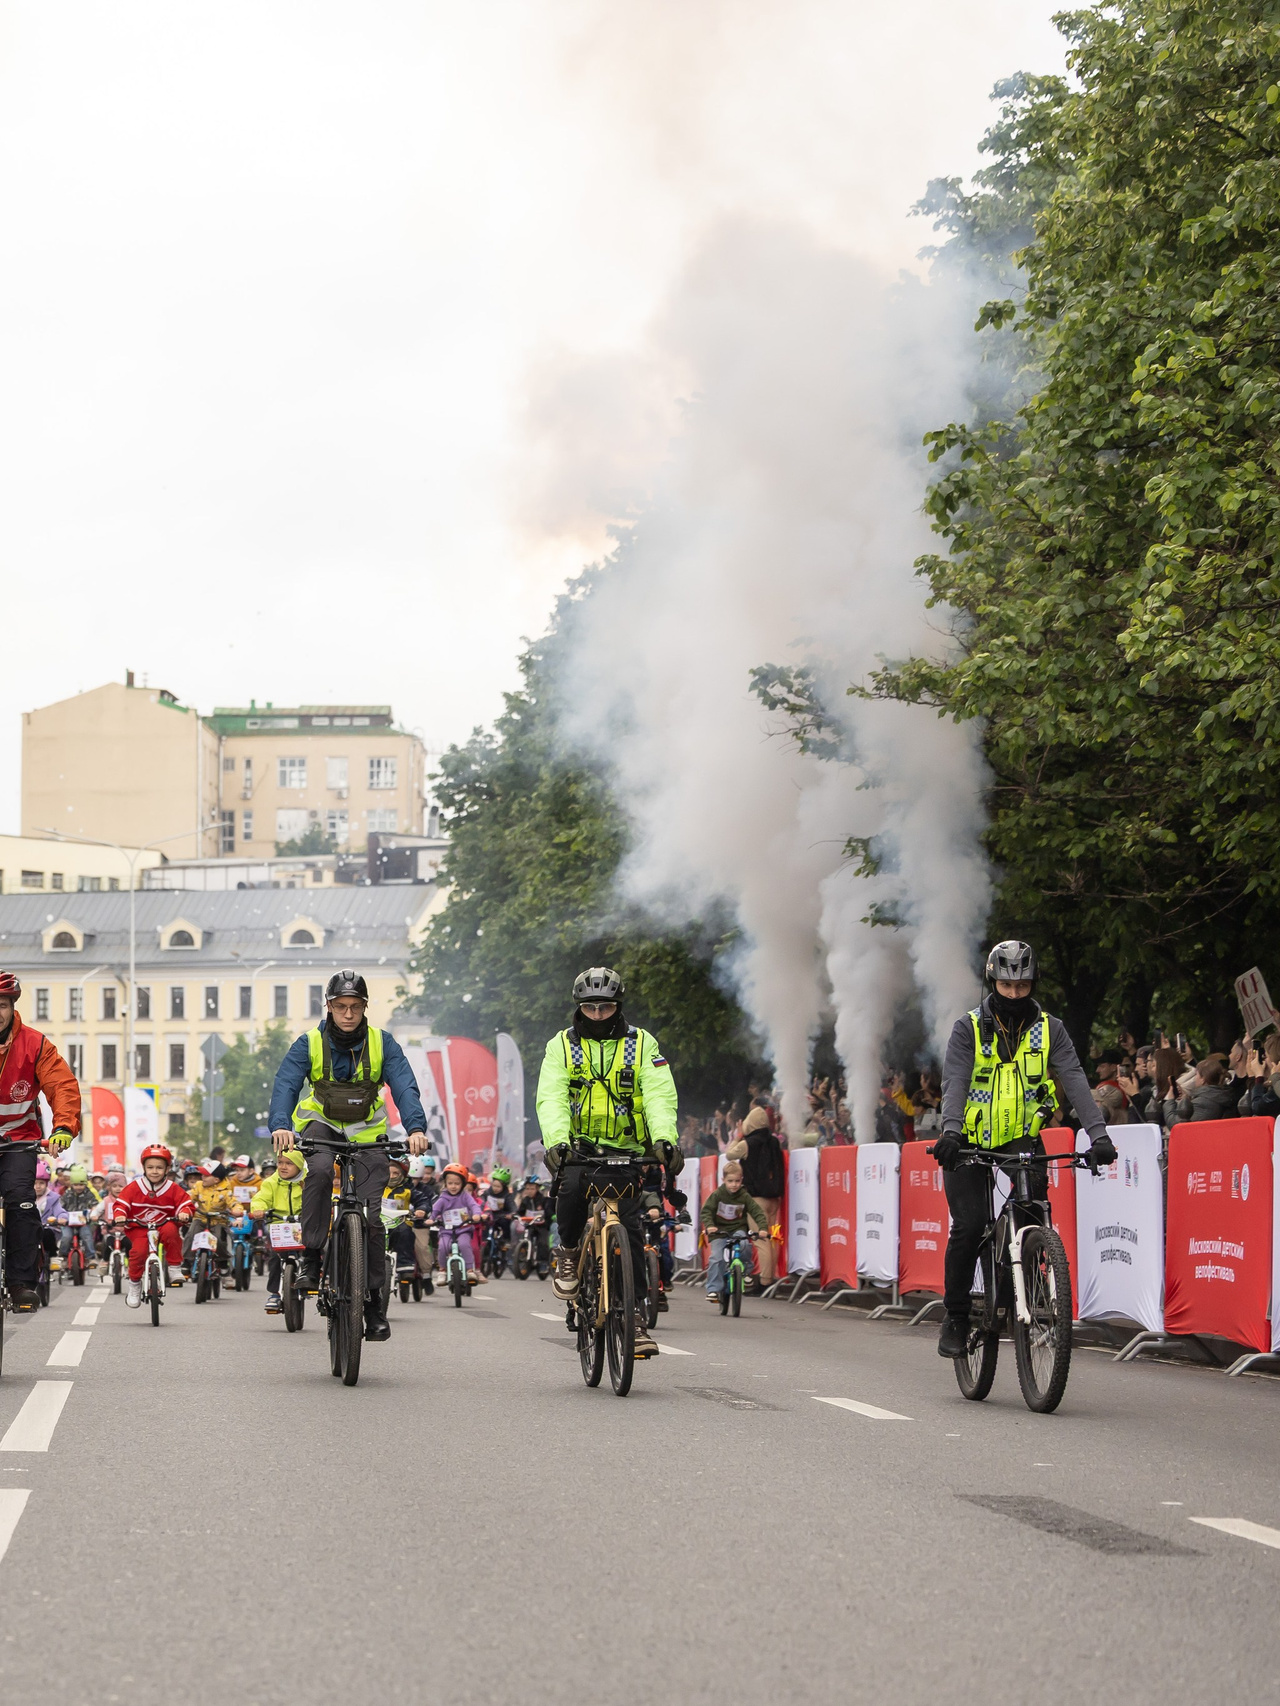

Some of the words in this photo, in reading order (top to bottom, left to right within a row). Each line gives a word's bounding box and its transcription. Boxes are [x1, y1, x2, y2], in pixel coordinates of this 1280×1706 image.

[1189, 1237, 1222, 1255] Московский
[1222, 1241, 1244, 1260] детский
[1195, 1260, 1235, 1282] велофестиваль
